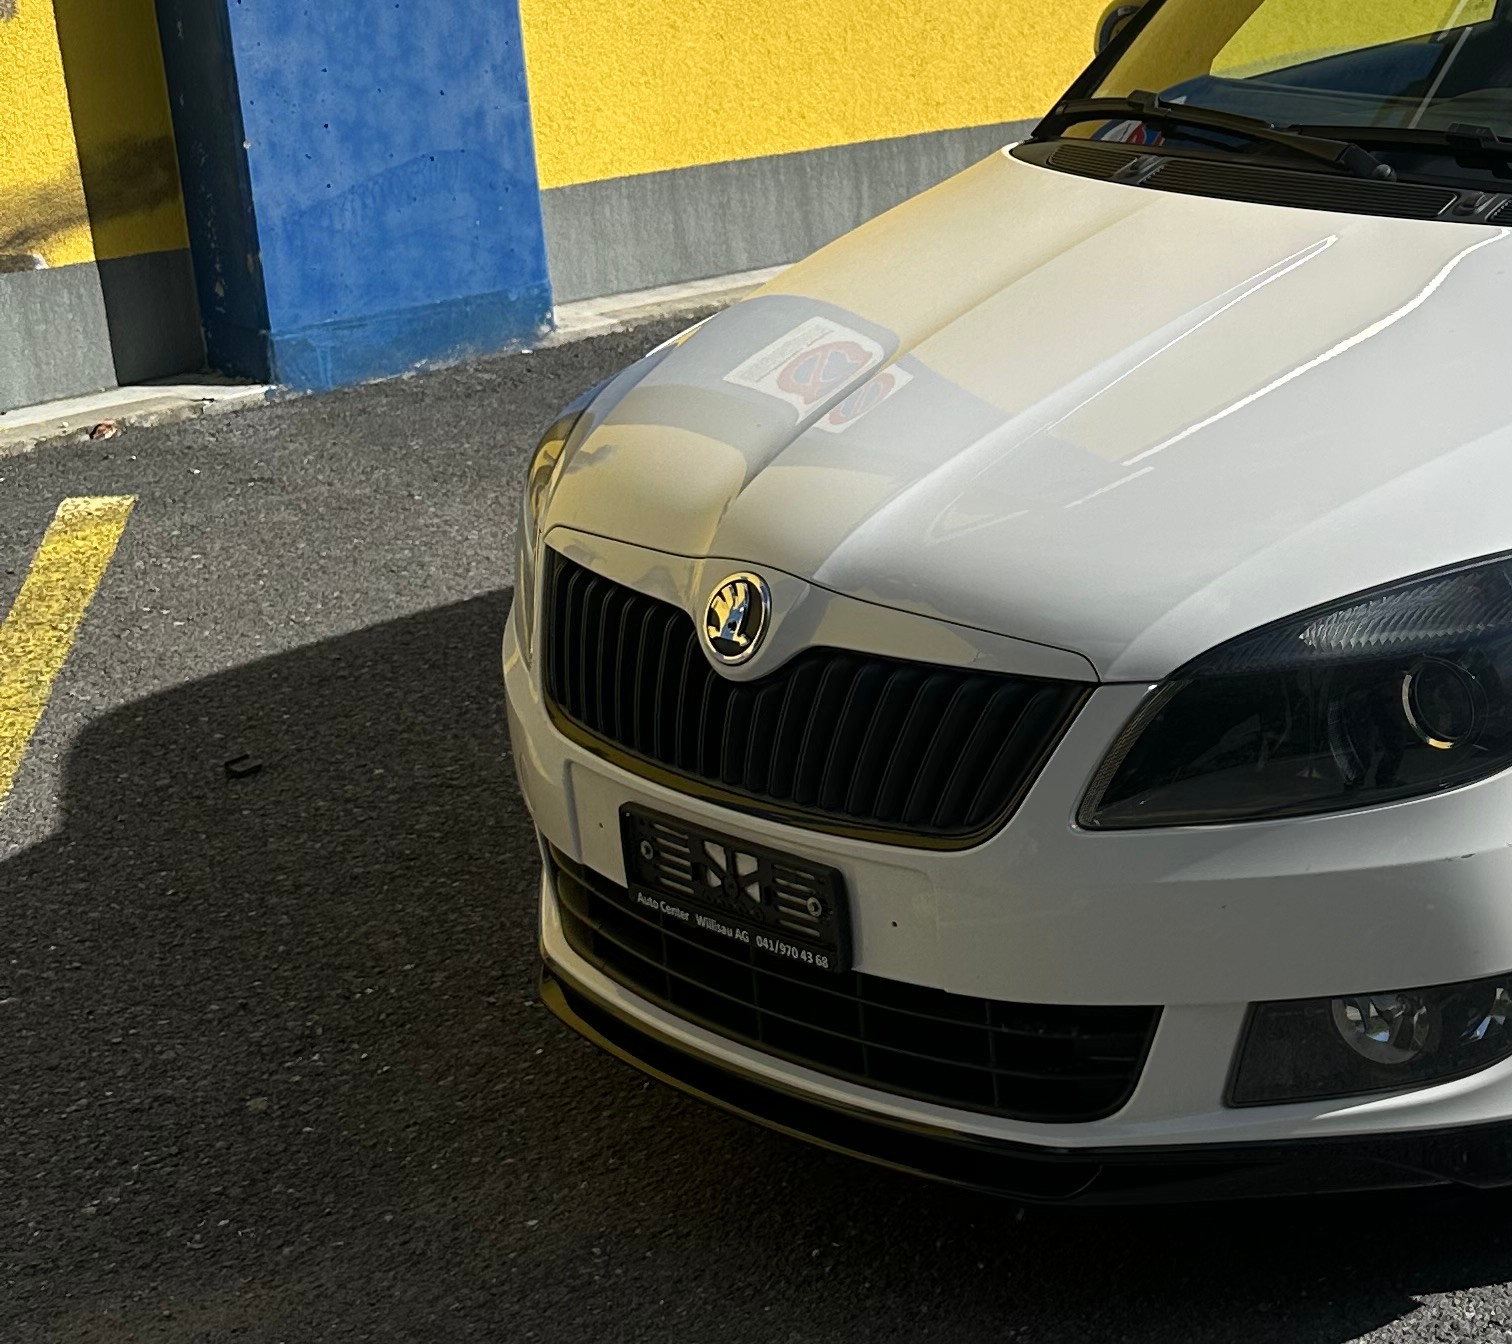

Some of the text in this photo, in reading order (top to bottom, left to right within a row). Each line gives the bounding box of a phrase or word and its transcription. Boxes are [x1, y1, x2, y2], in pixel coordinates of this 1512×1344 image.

[637, 891, 659, 910] Auto
[660, 900, 690, 922] Center
[735, 927, 750, 944] AG
[755, 934, 799, 959] 041/970
[800, 949, 814, 964] 43
[815, 954, 829, 969] 68
